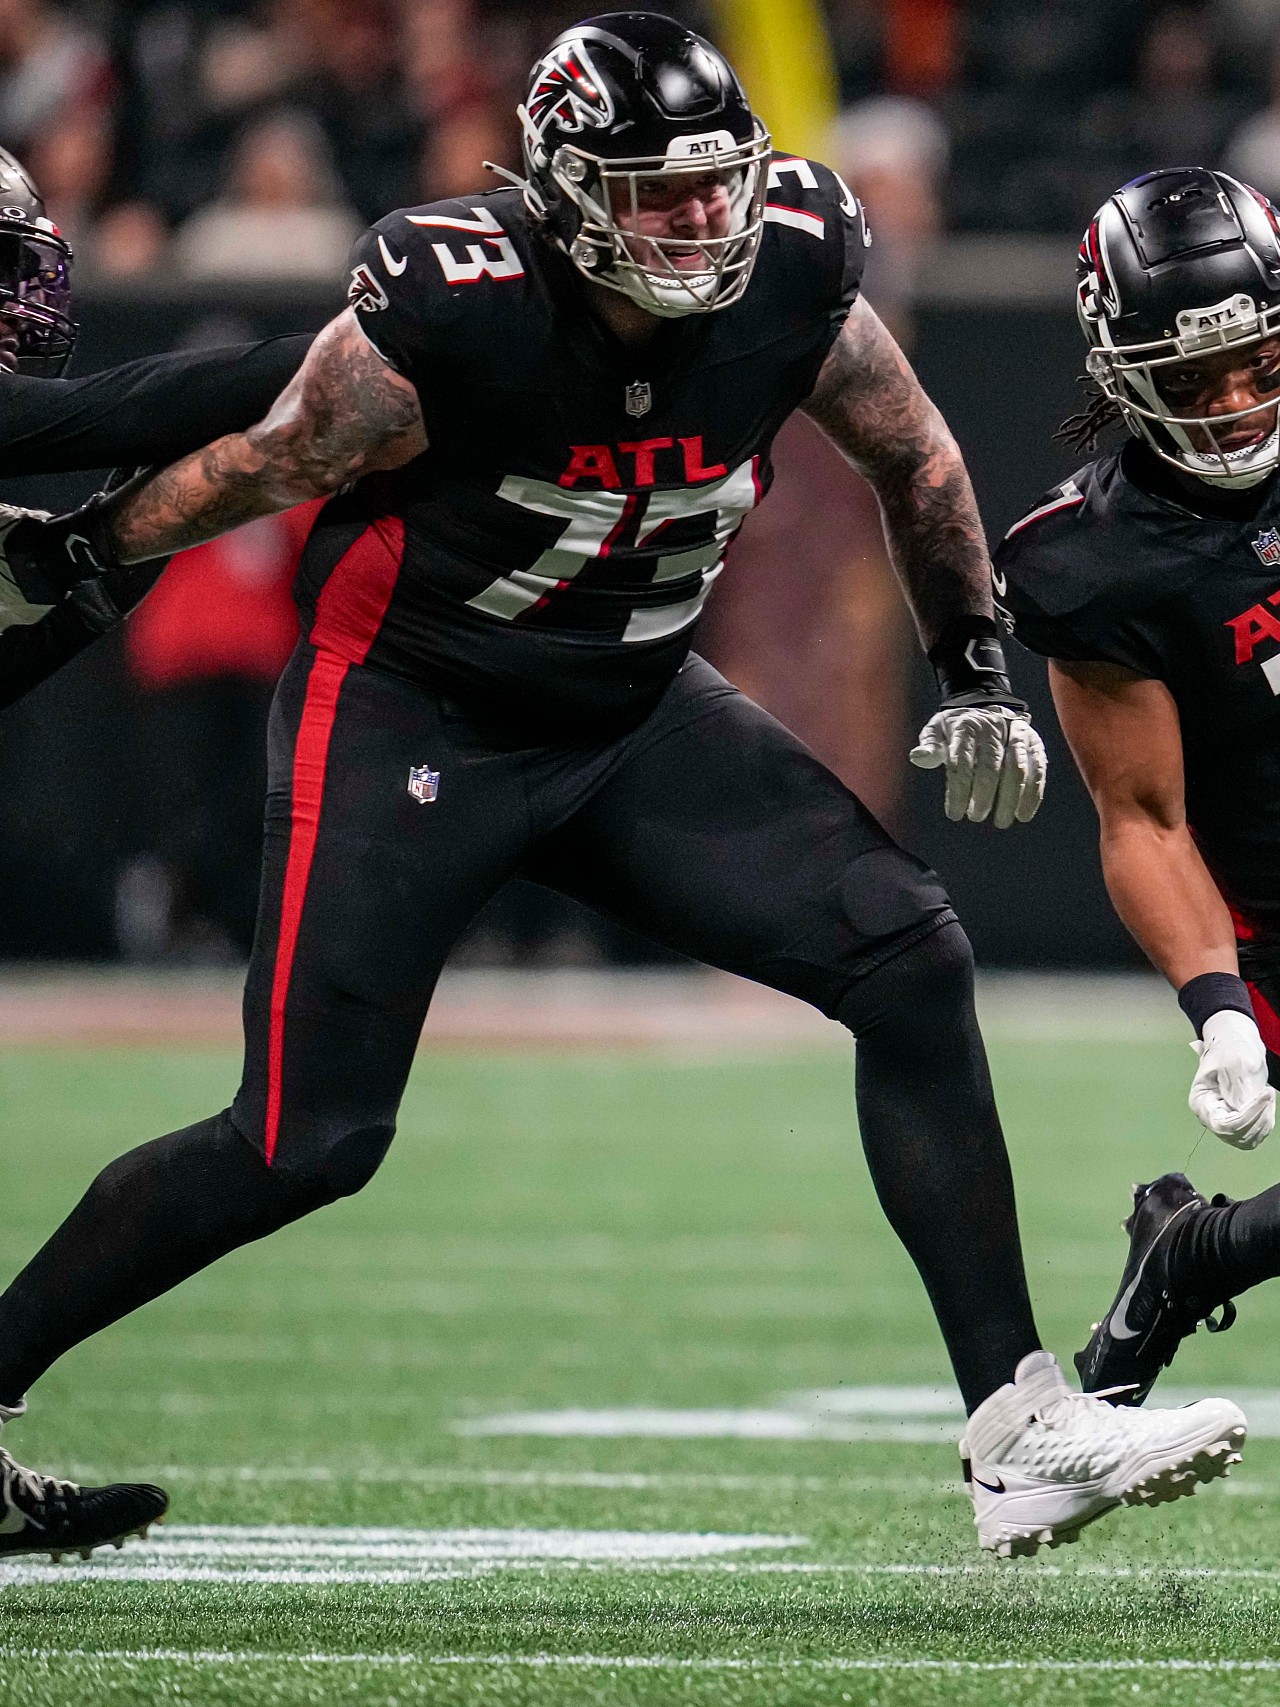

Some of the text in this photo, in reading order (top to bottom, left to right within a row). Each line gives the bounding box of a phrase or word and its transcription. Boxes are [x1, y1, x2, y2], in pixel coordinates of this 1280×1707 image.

[687, 139, 723, 155] ATL
[404, 207, 526, 287] 73
[1196, 308, 1237, 328] ATL
[558, 435, 729, 489] ATL
[464, 454, 764, 643] 73
